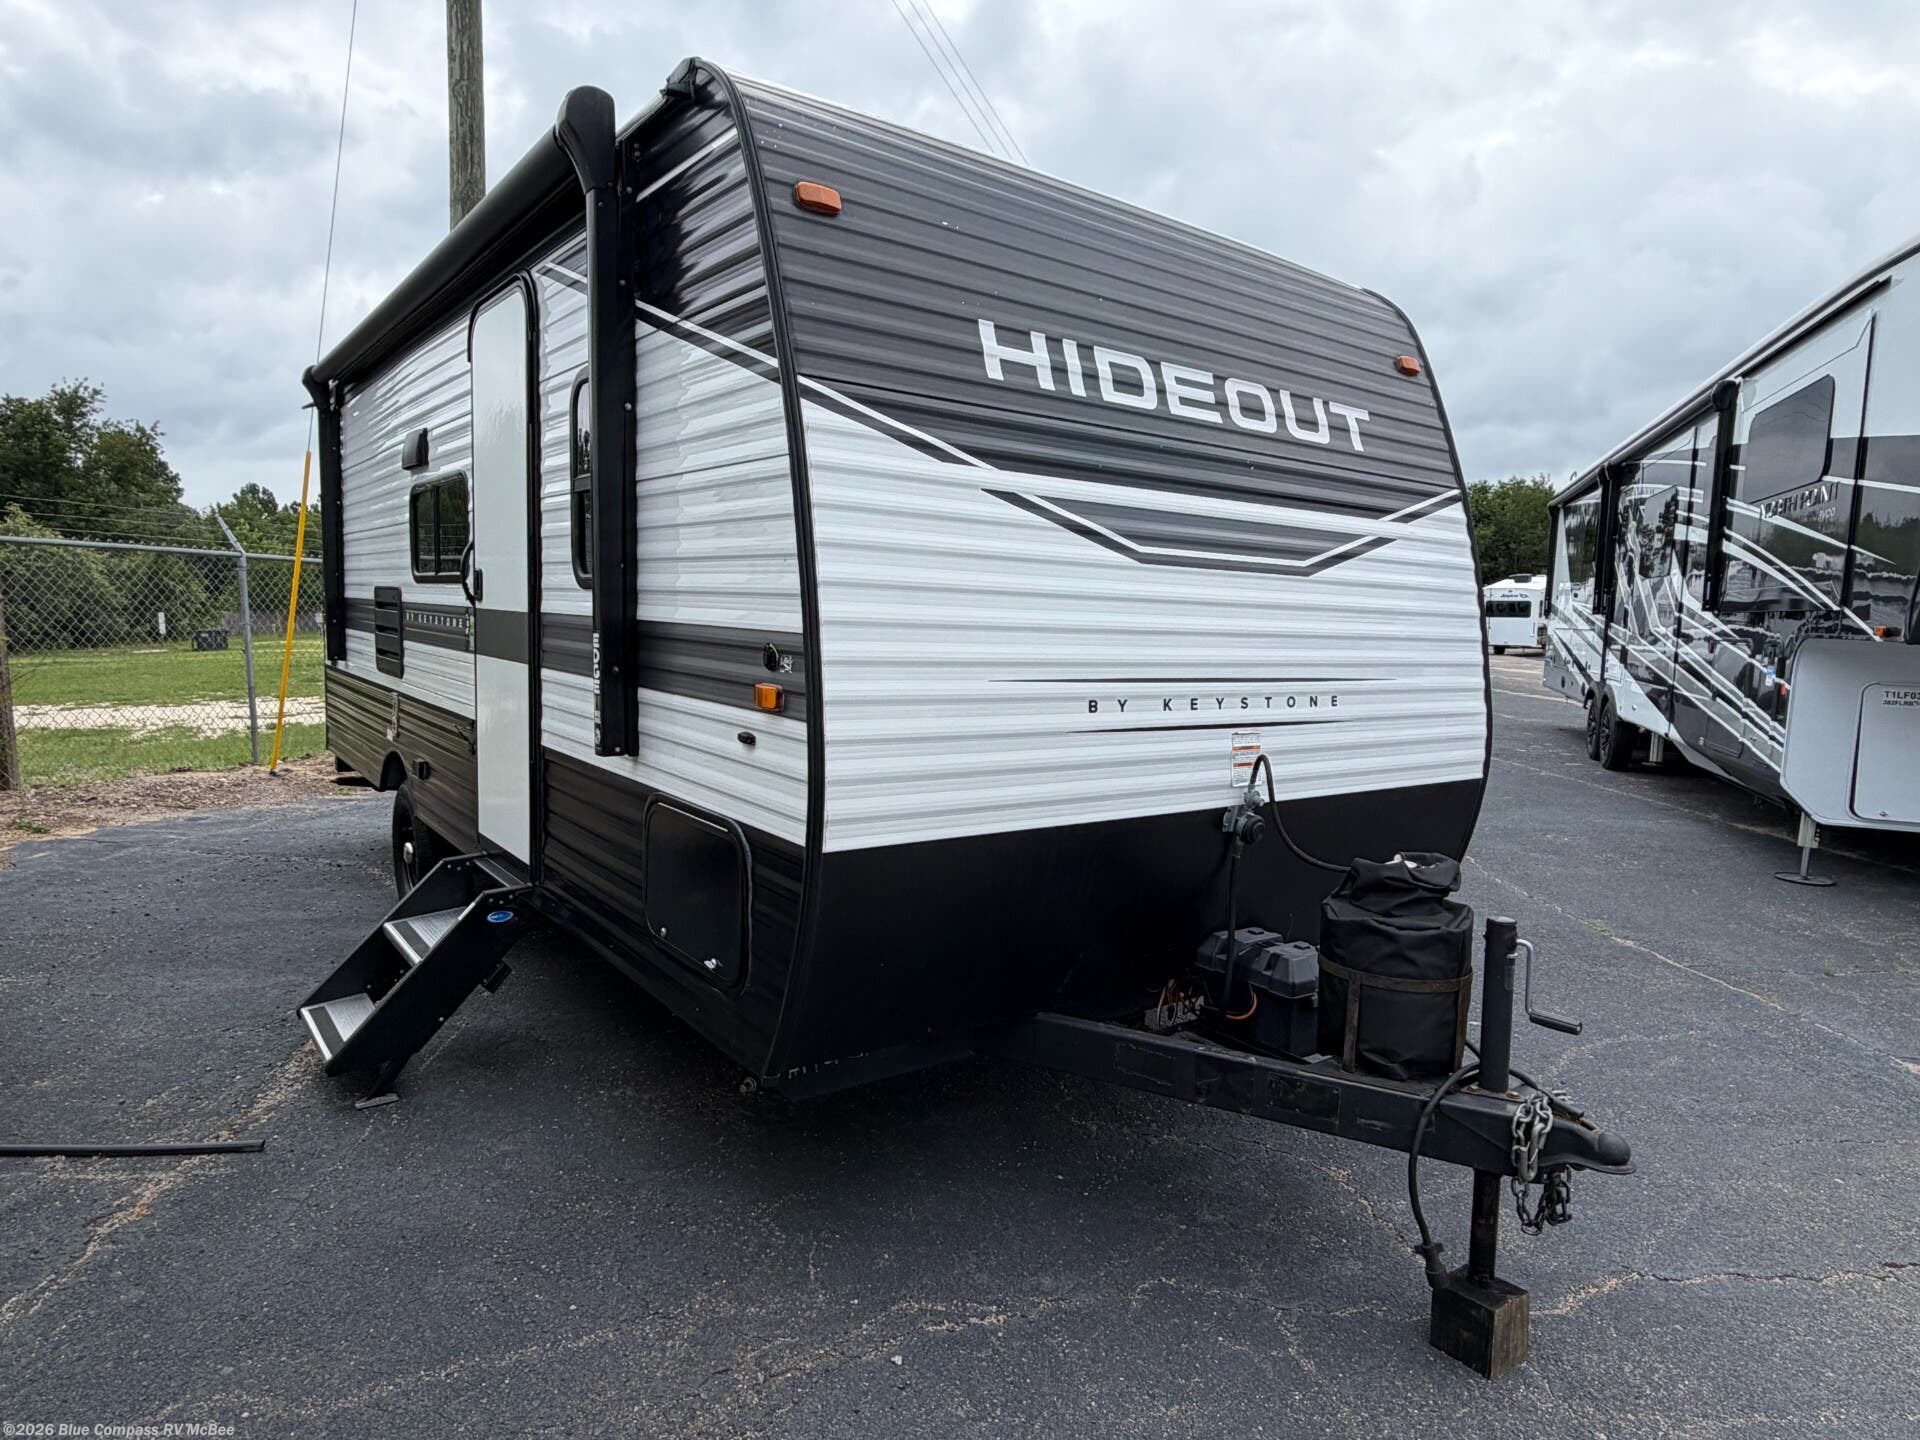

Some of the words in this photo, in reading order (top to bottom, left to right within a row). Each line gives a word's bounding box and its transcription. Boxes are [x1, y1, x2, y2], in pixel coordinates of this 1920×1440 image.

[978, 318, 1370, 452] HIDEOUT
[1088, 699, 1128, 713] BY
[1163, 695, 1338, 712] KEYSTONE
